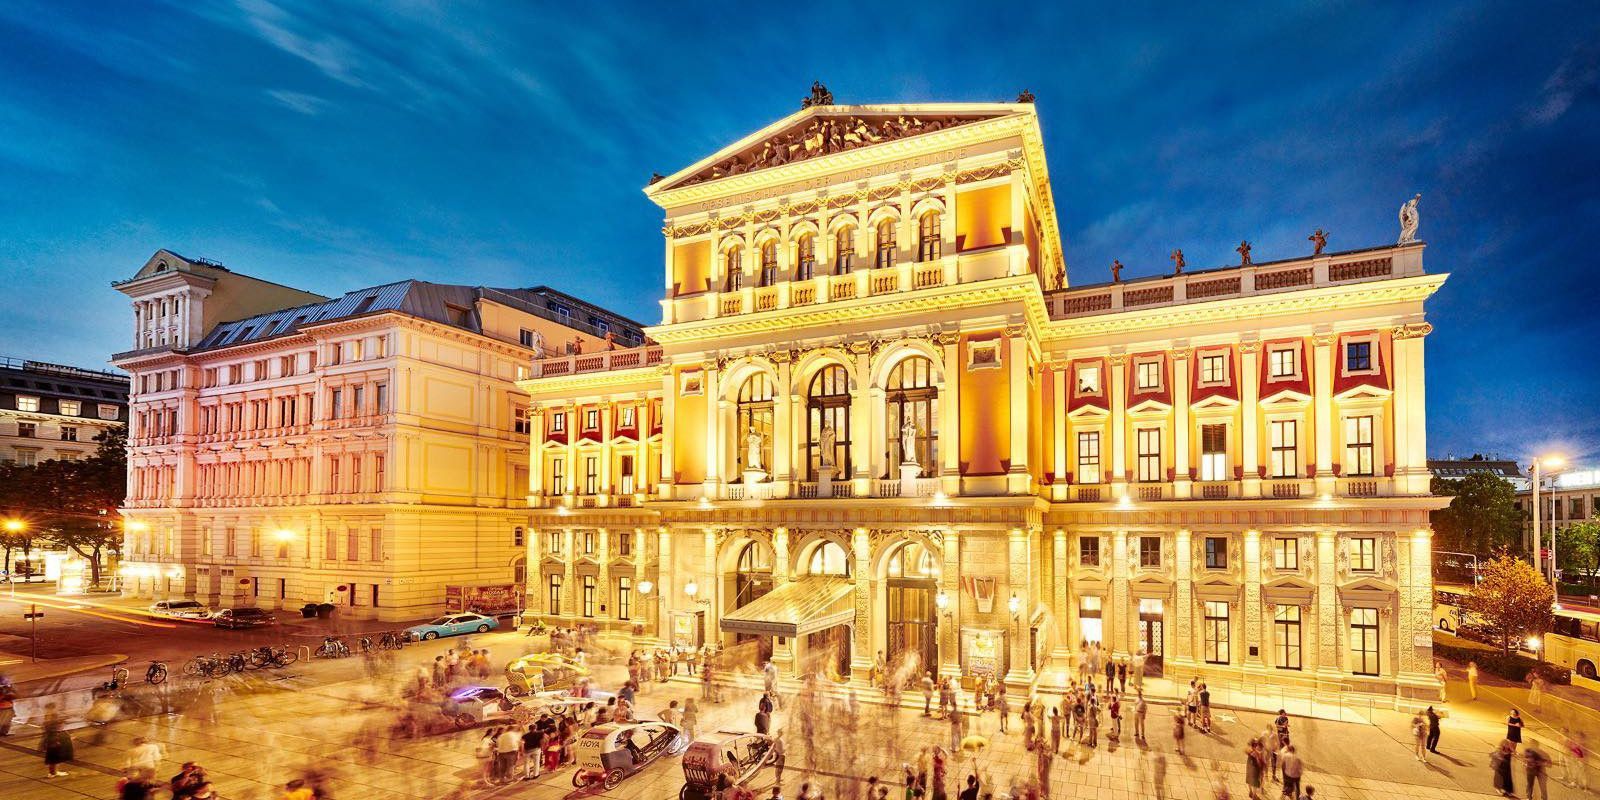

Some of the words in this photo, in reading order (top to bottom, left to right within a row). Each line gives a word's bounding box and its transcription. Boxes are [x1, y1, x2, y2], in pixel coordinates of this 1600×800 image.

[701, 184, 795, 211] GESELLSCHAFT
[804, 176, 832, 190] DER
[842, 148, 968, 183] MUSIKFREUNDE
[580, 740, 600, 748] HOYA
